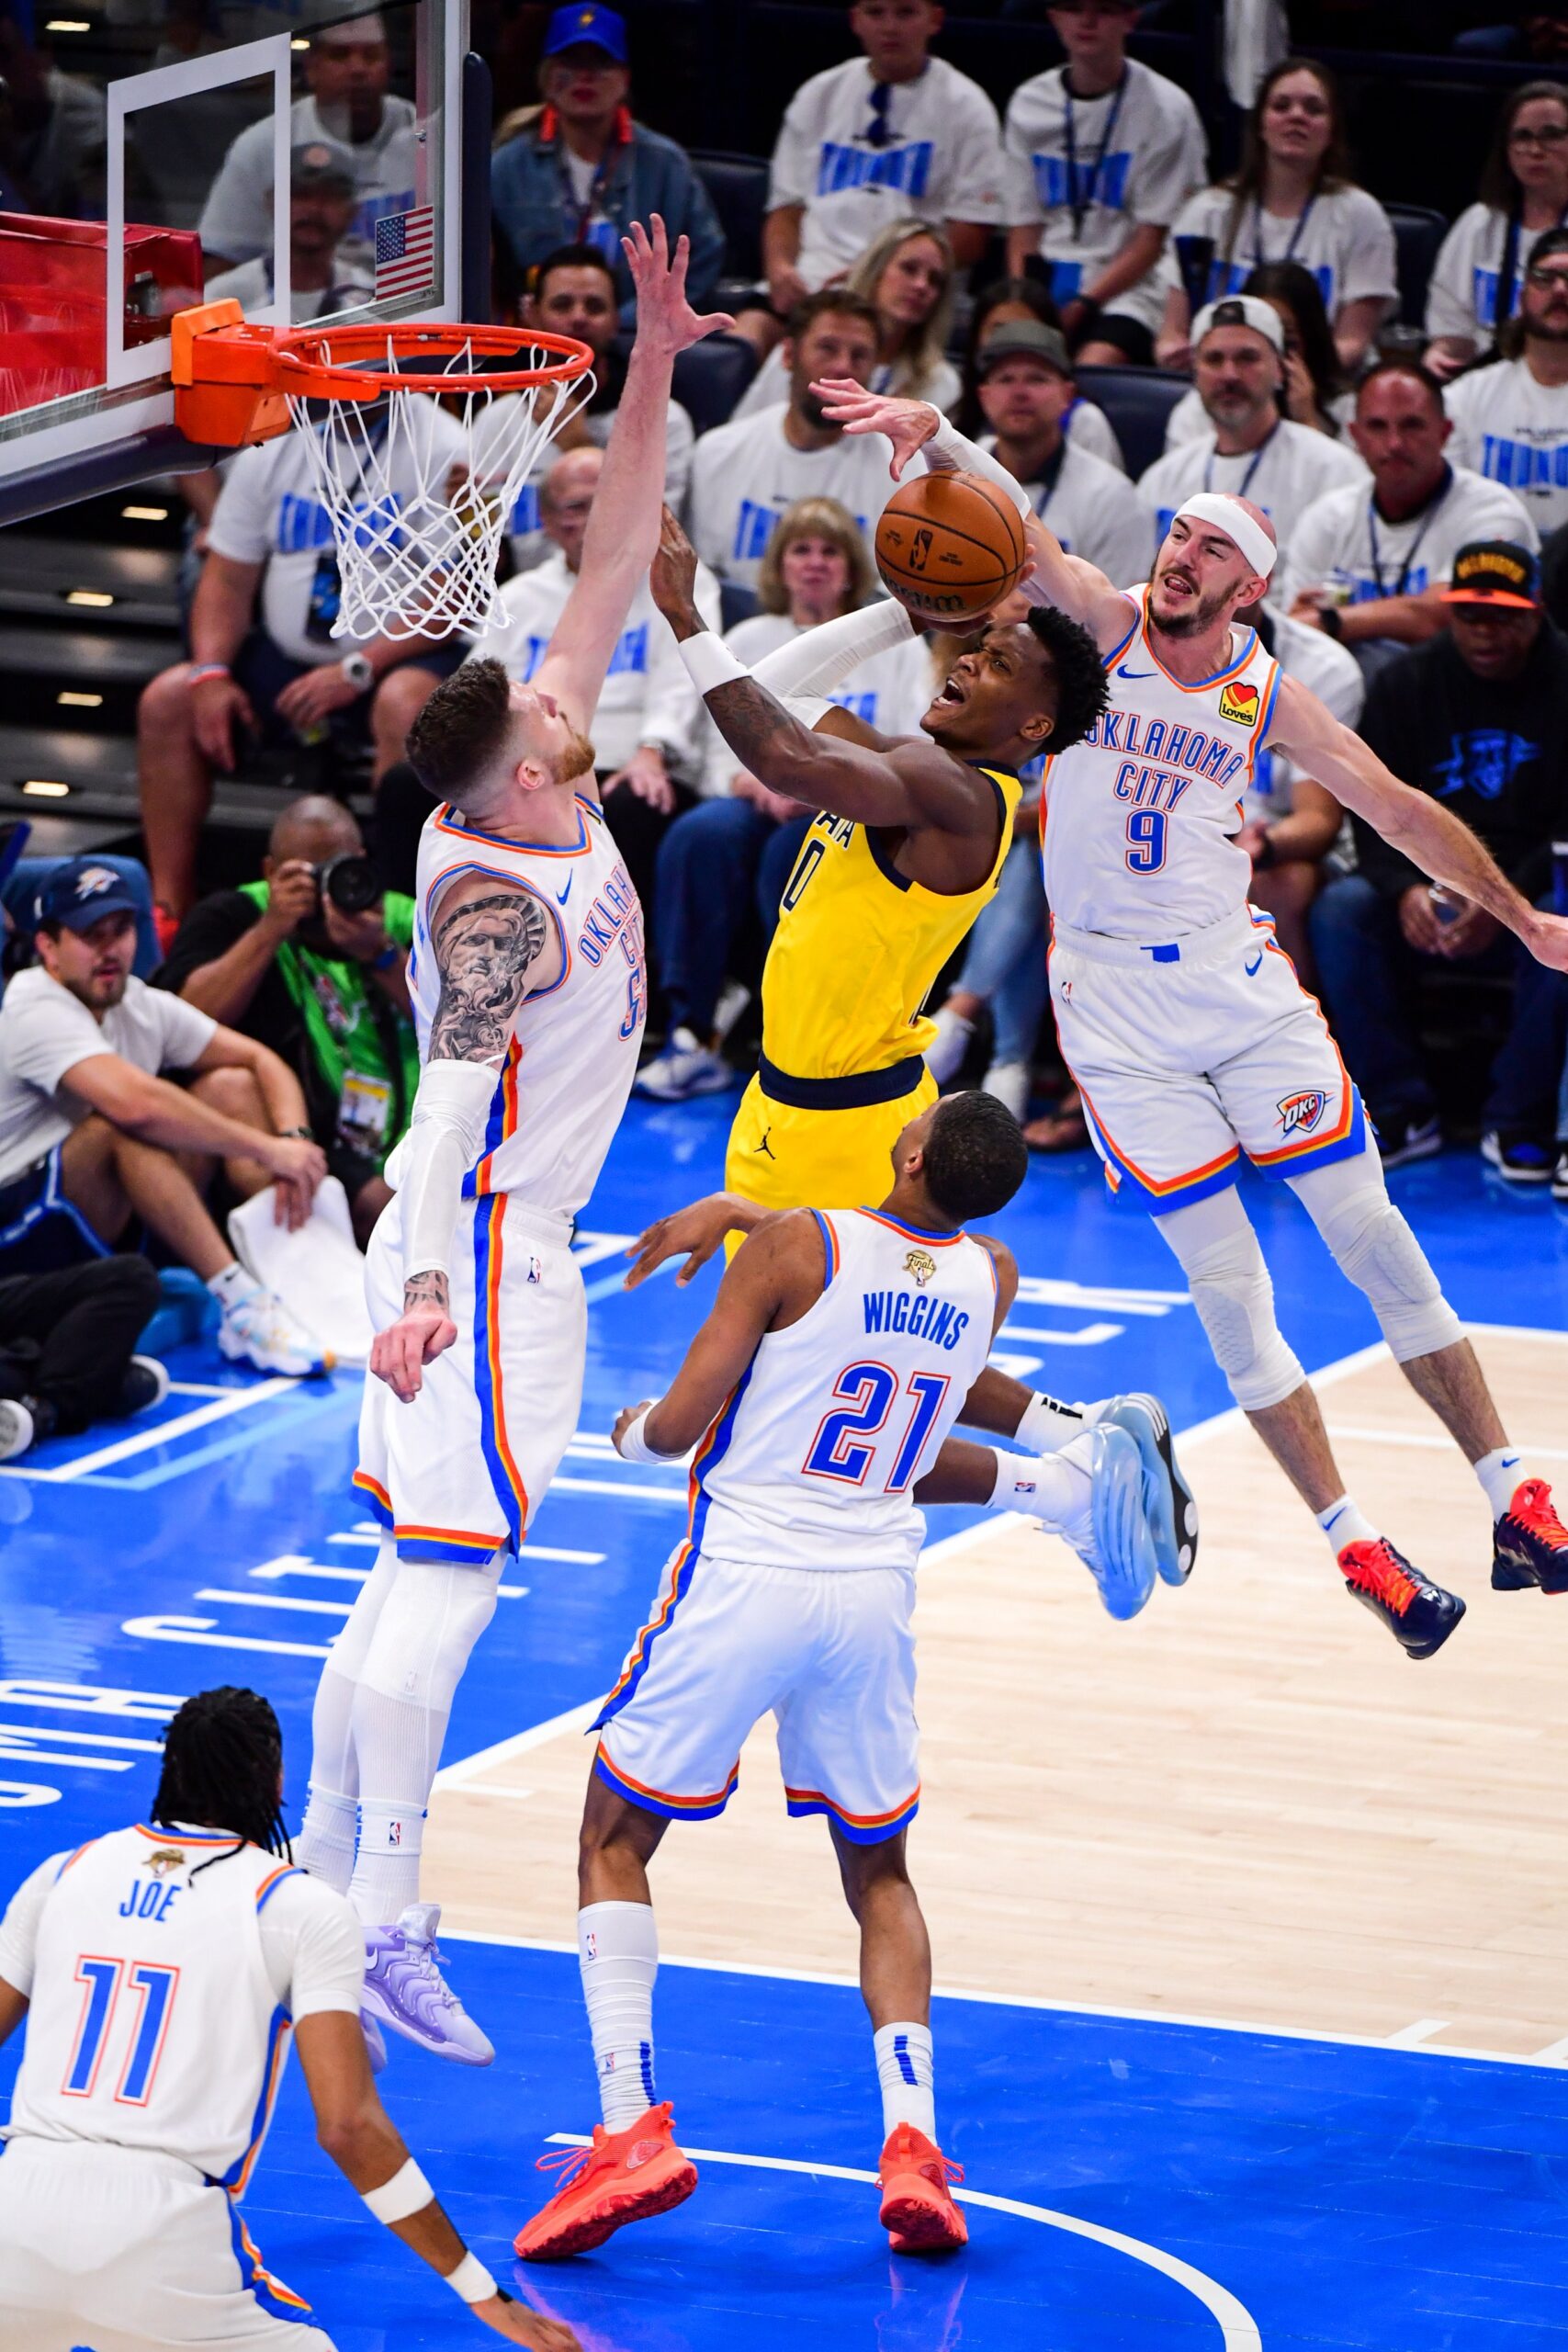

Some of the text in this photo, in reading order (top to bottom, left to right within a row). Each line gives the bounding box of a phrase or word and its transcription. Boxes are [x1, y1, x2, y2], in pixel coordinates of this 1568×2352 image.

[1113, 761, 1193, 812] CITY
[1125, 808, 1168, 876] 9
[578, 861, 639, 968] OKLAH
[1283, 1094, 1315, 1132] OKC
[863, 1291, 970, 1351] WIGGINS
[801, 1360, 952, 1494] 21
[118, 1880, 182, 1922] JOE
[60, 1954, 181, 2107] 11
